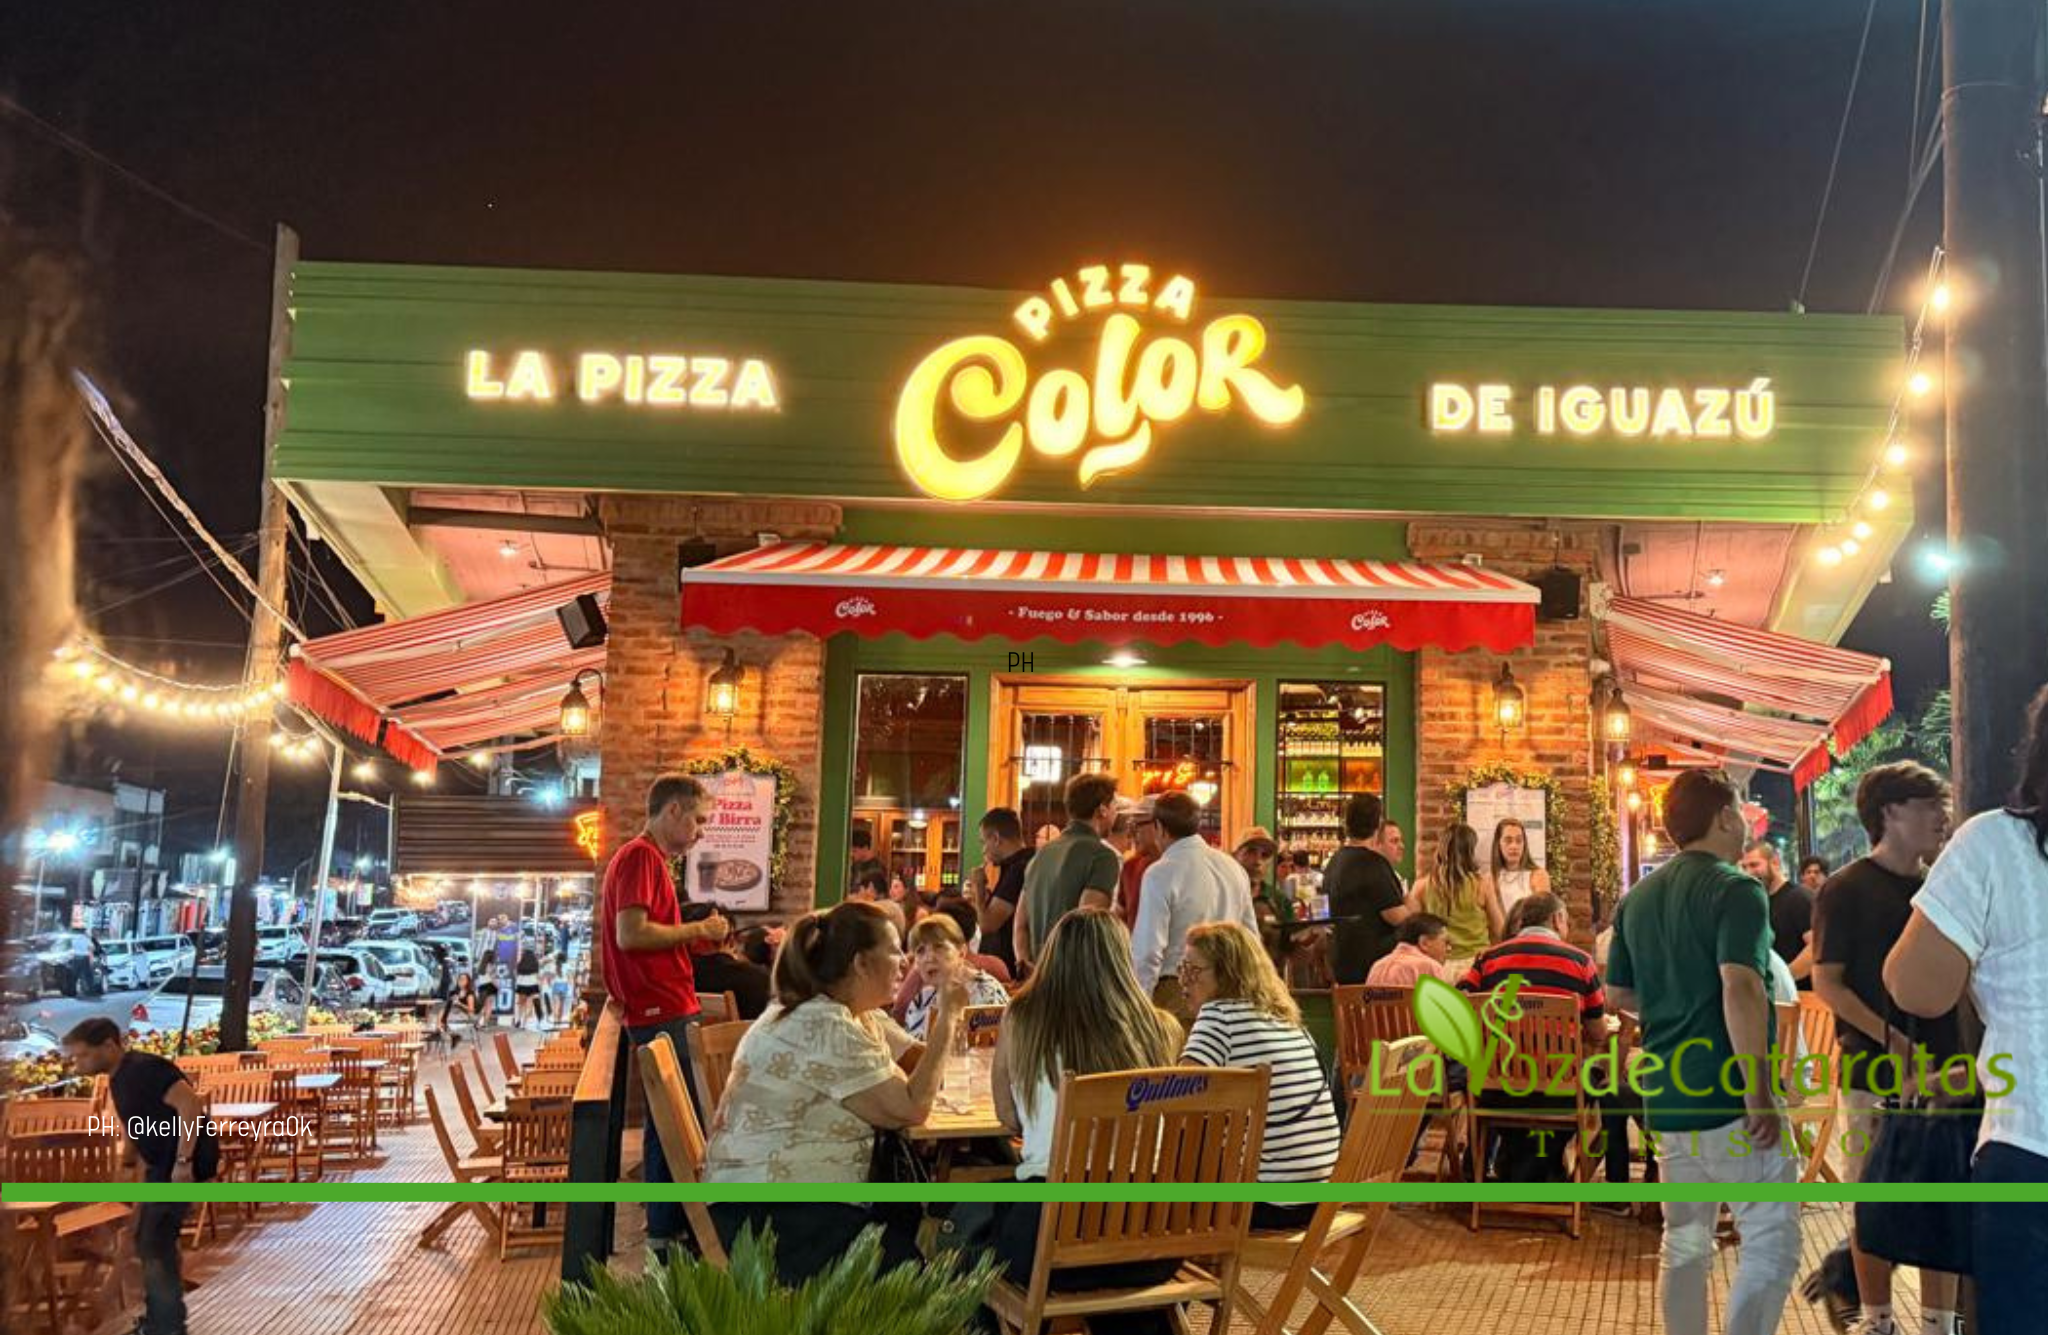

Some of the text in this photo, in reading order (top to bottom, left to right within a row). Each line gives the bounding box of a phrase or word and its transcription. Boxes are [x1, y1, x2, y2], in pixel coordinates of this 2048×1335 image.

[1012, 263, 1196, 342] PIZZA
[465, 349, 777, 408] LA PIZZA
[1431, 377, 1775, 438] DE IGUAZÚ
[1018, 606, 1214, 623] Fuego & Sabor desde 1996
[1126, 1074, 1209, 1112] Quilmes
